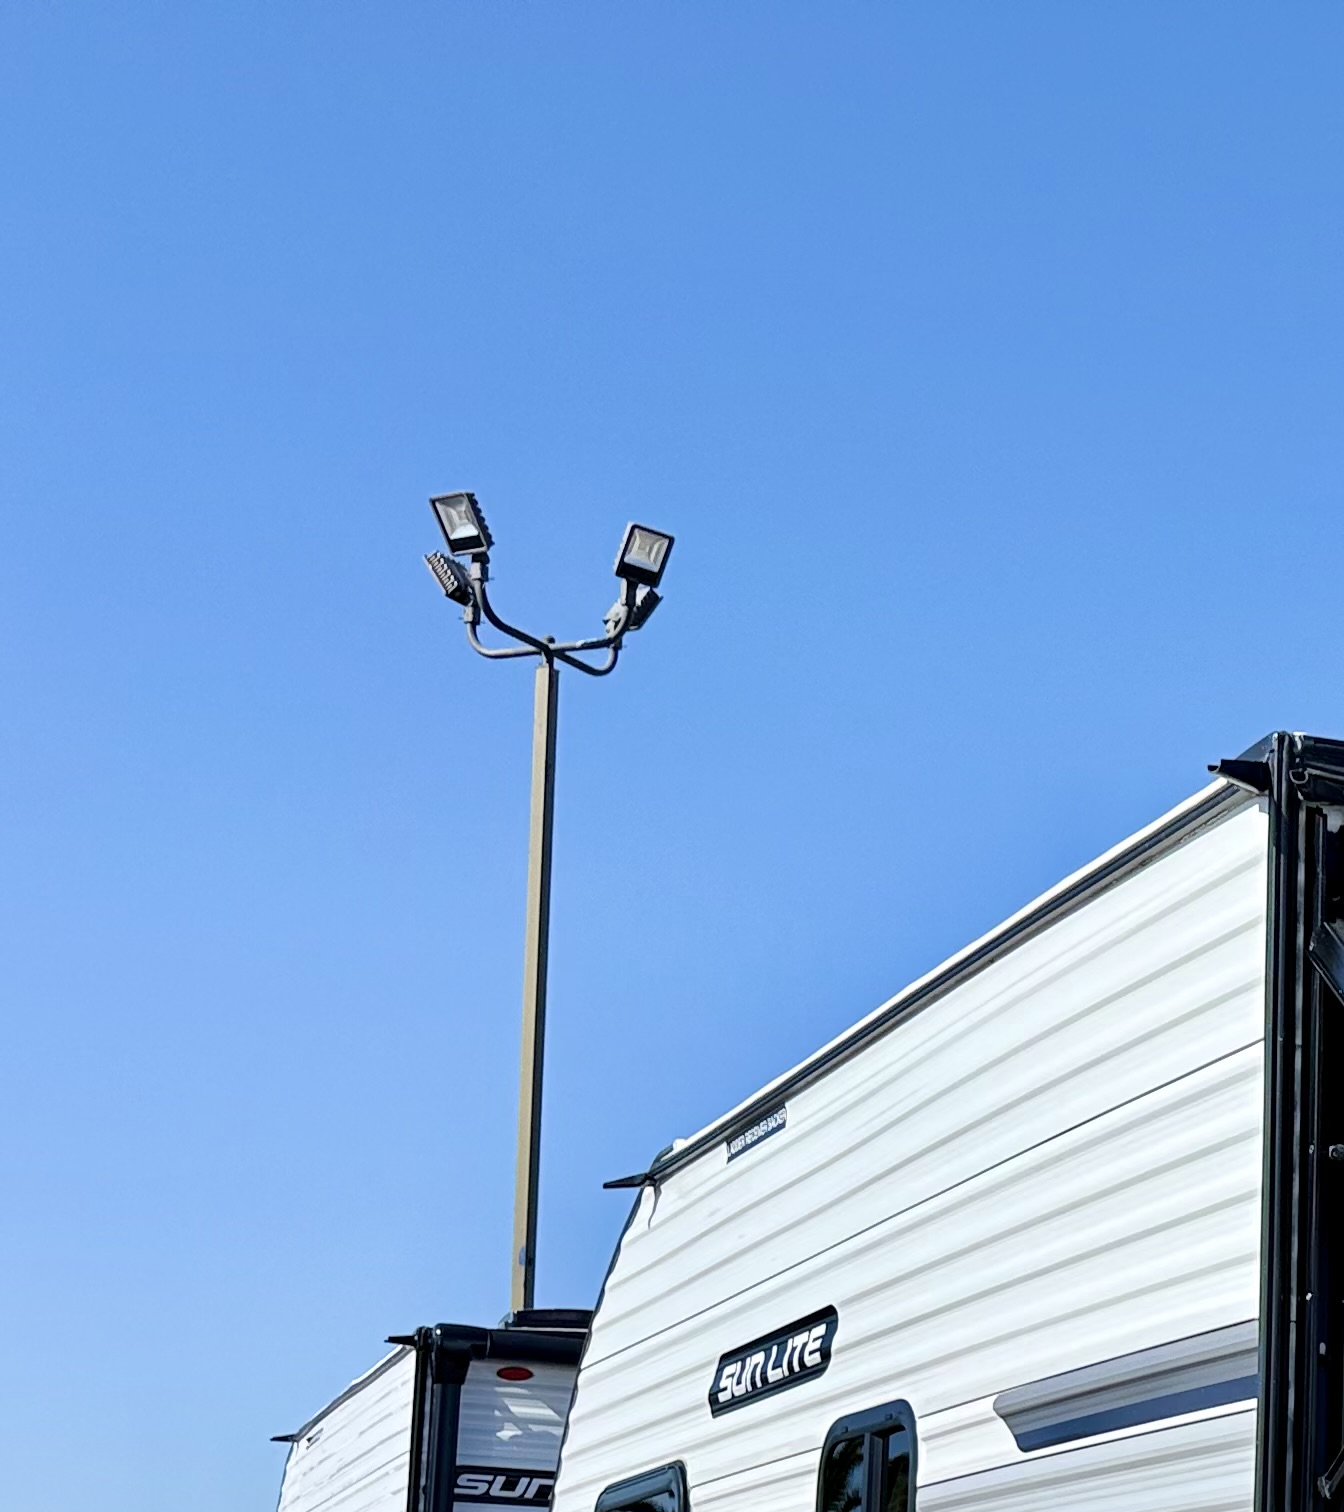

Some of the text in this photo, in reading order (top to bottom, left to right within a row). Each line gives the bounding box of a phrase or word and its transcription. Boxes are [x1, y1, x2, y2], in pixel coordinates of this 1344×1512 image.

[718, 1323, 827, 1403] SUN LITE
[453, 1473, 555, 1500] SUN
